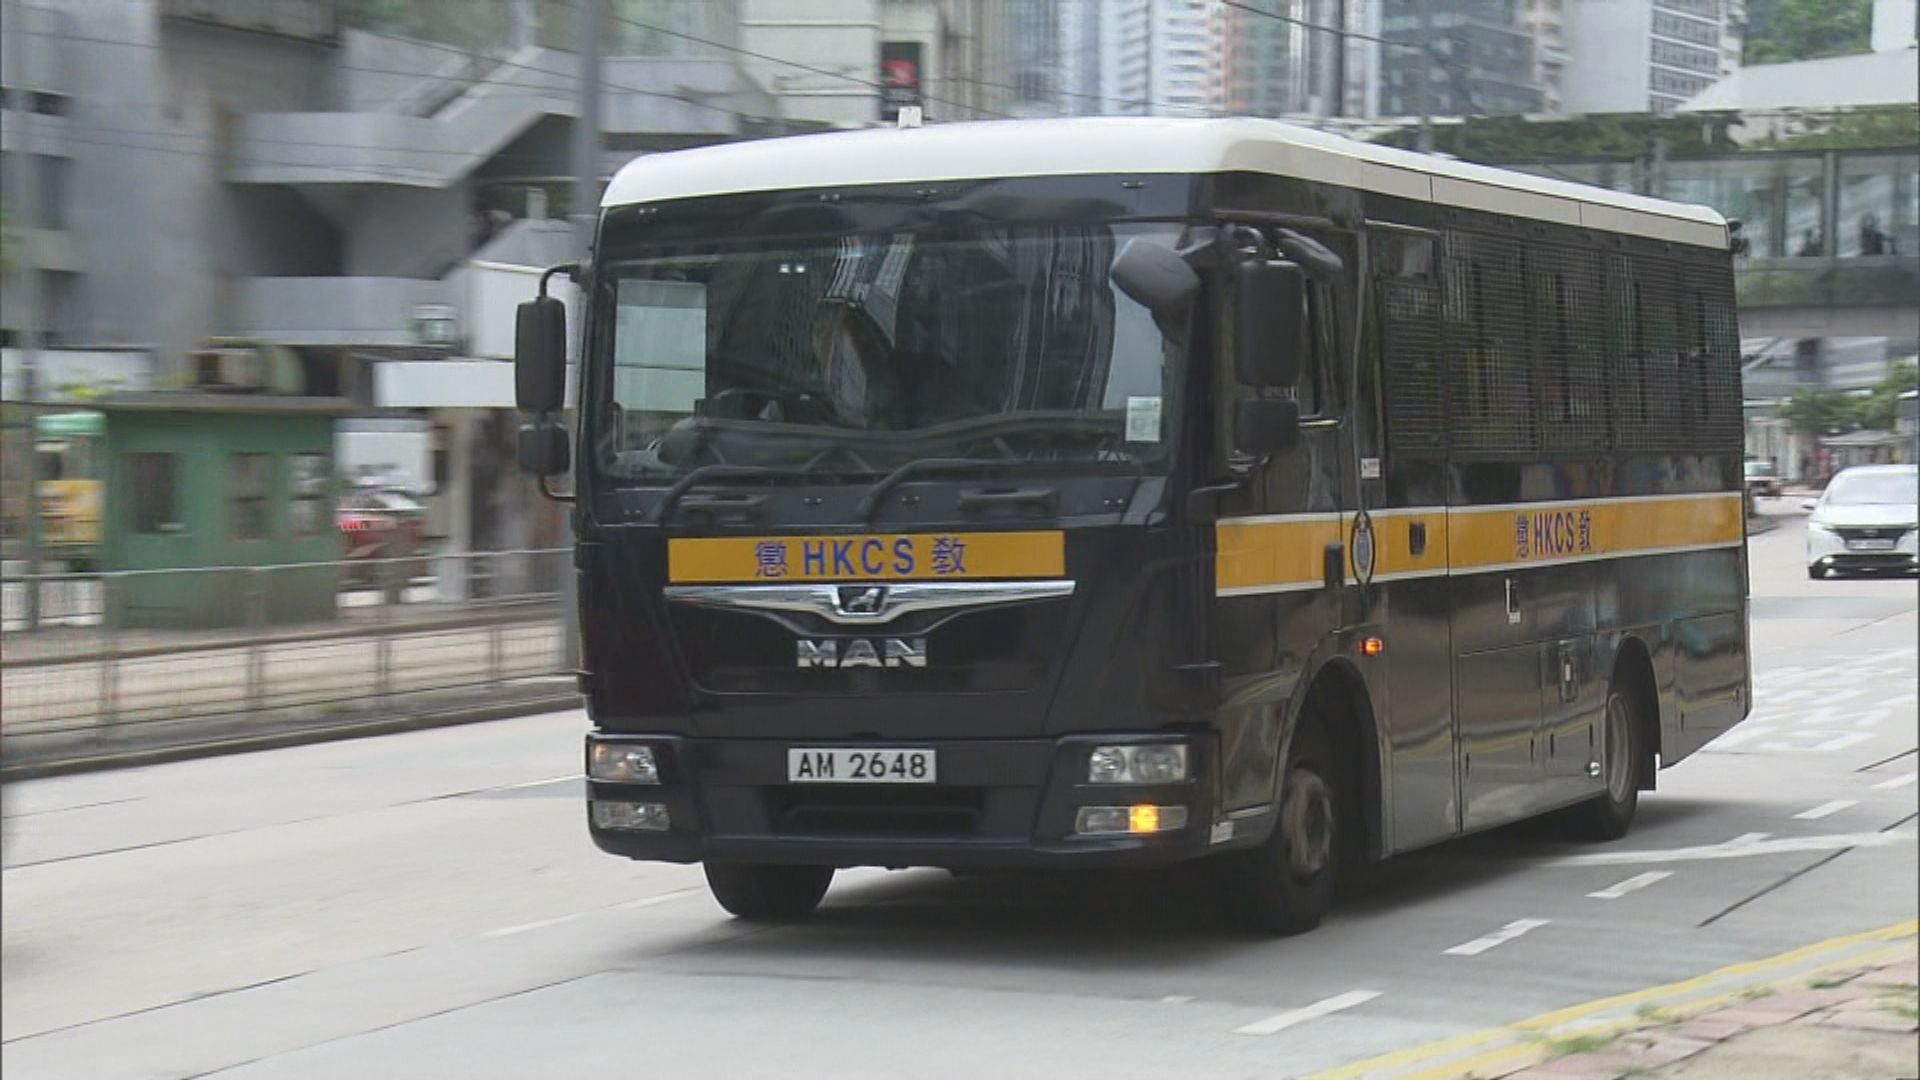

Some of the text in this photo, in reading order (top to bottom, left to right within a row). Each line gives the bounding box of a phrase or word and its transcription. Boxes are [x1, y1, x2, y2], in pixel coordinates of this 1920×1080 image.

[1534, 511, 1574, 555] HKCS
[803, 538, 914, 576] HKCS
[797, 639, 926, 668] MAN
[798, 752, 926, 778] AM 2648
